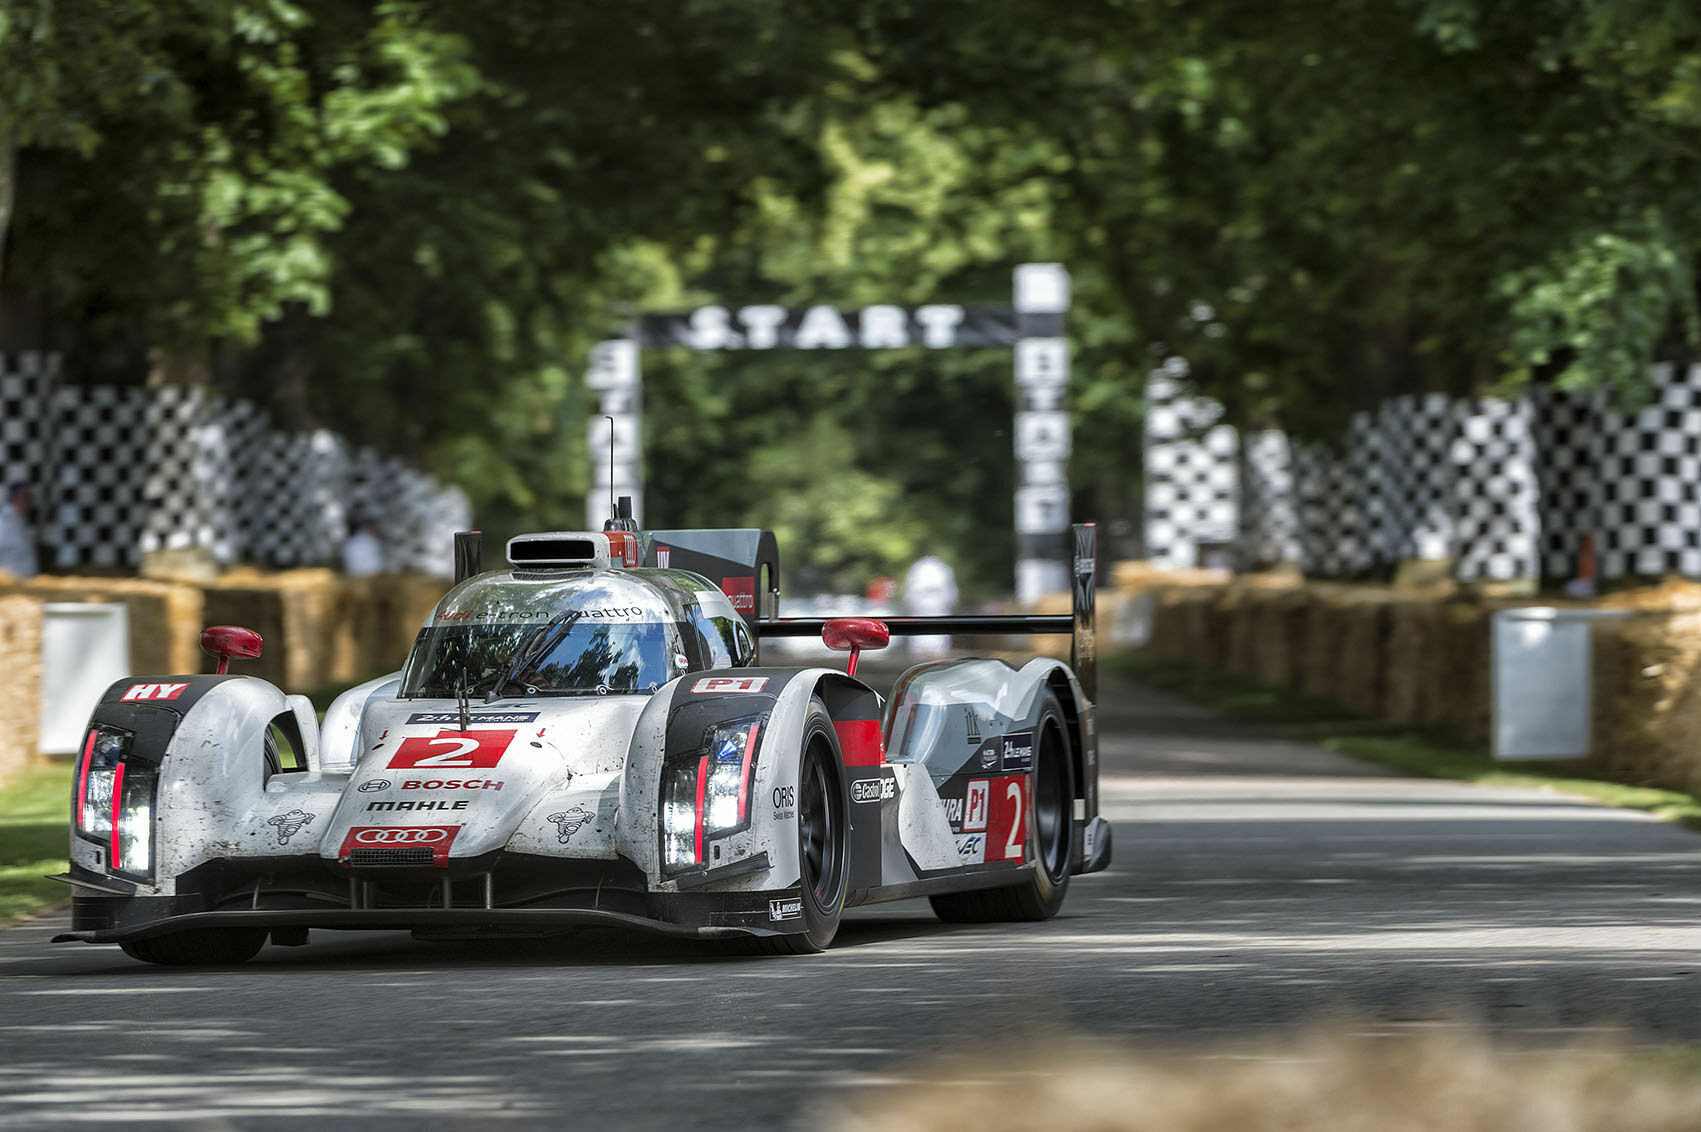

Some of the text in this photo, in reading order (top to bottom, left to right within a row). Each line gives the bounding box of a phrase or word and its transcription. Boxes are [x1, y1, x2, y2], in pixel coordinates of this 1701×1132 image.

[689, 304, 964, 350] START
[476, 611, 549, 620] e-tron
[572, 606, 643, 619] uattro
[123, 683, 188, 700] HY
[705, 679, 754, 690] P1
[413, 737, 480, 767] 2
[401, 780, 504, 791] BOSCH
[366, 800, 469, 811] MAHLE
[772, 785, 795, 809] ORIS
[968, 788, 985, 822] P1
[1004, 781, 1022, 859] 2
